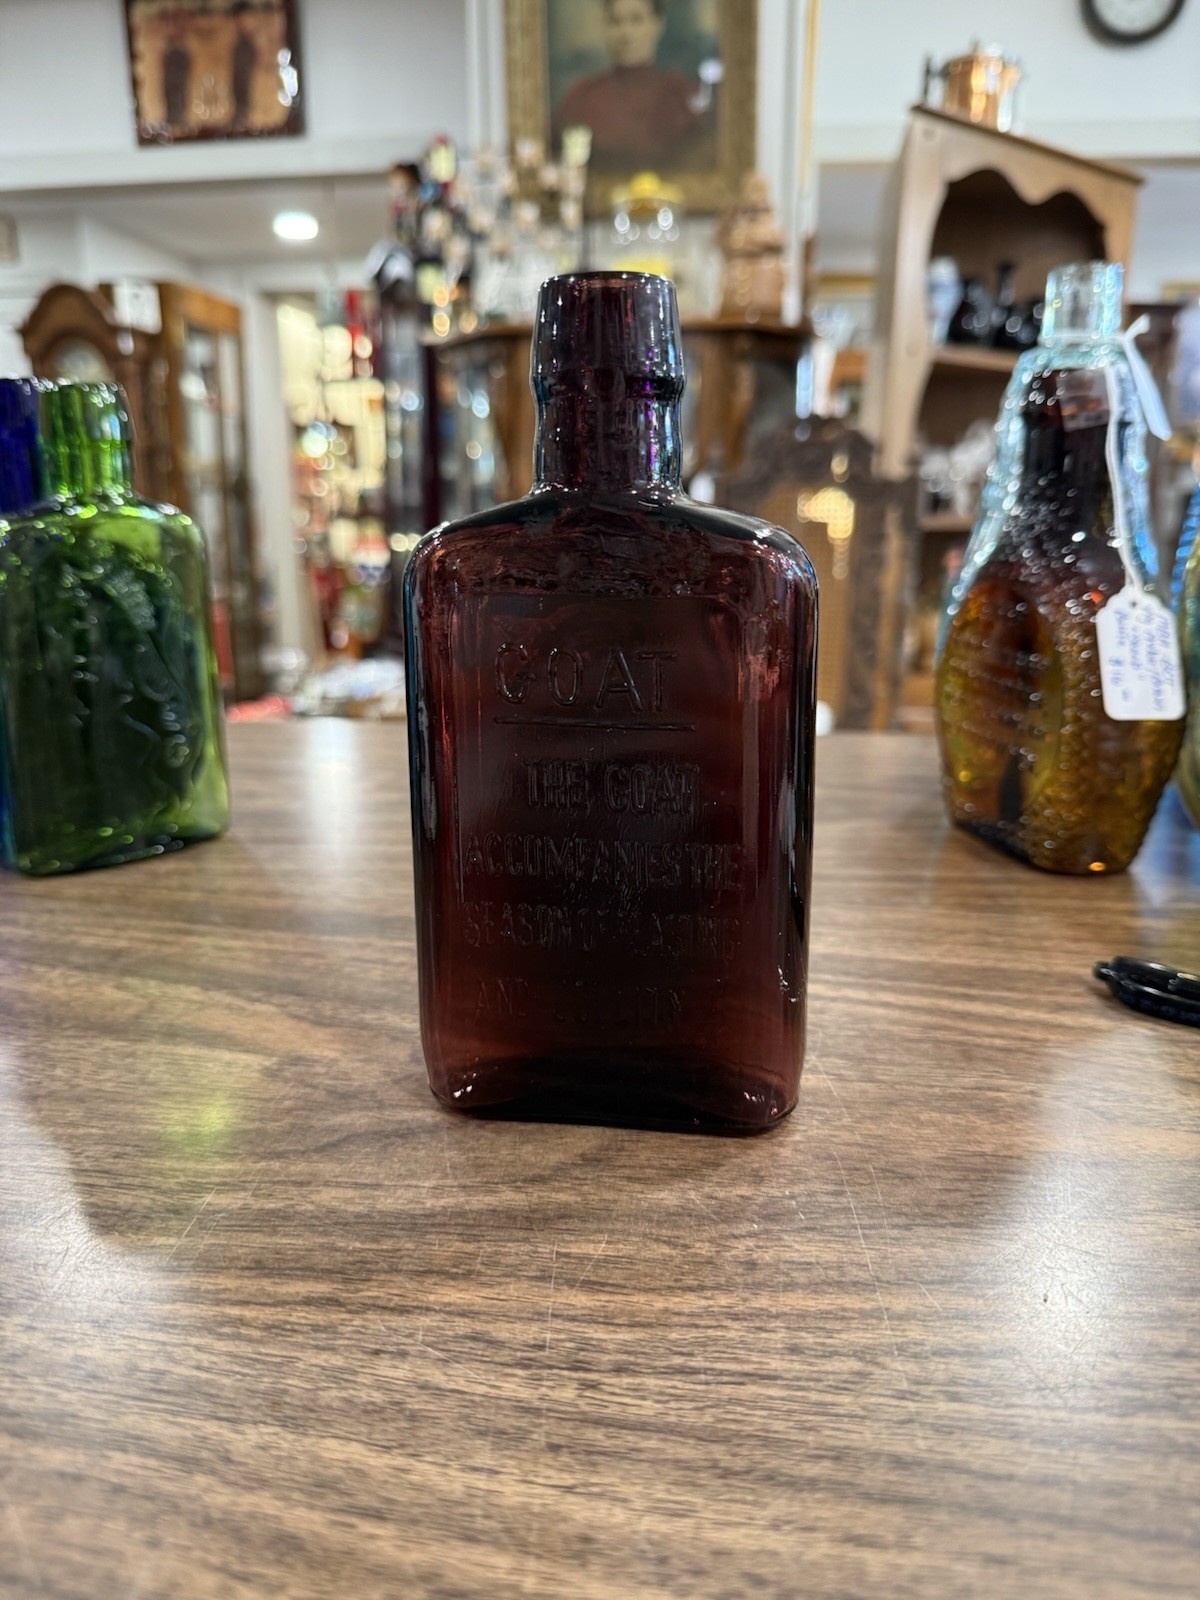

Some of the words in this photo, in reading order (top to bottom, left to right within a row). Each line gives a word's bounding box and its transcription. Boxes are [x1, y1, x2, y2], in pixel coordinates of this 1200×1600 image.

[494, 641, 679, 713] GOAT
[523, 757, 590, 808] THE
[464, 832, 682, 888] ACCOMPANIES
[685, 843, 746, 890] THE
[463, 901, 573, 950] SEASON
